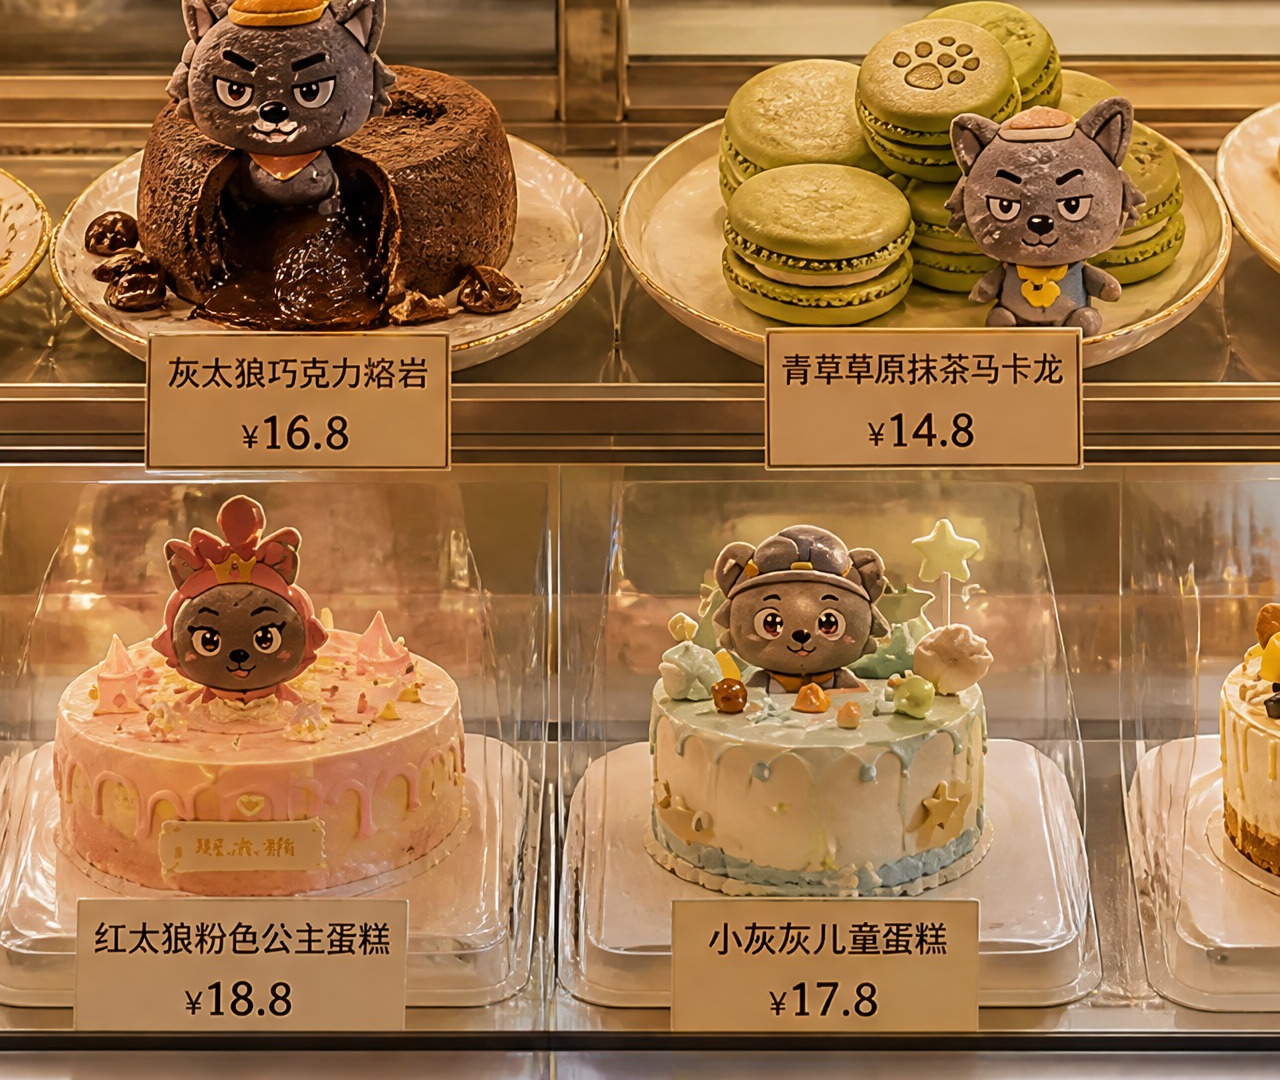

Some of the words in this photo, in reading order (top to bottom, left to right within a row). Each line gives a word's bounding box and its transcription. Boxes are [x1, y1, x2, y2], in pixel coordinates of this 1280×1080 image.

[781, 352, 1064, 386] 青草草原抹茶马卡龙
[241, 414, 349, 451] ¥16.8
[867, 412, 974, 448] ¥14.8
[94, 921, 391, 956] 红太狼粉色公主蛋糕
[708, 921, 948, 956] 小灰灰儿童蛋糕
[184, 980, 292, 1017] ¥18.8
[768, 981, 878, 1018] ¥17.8
